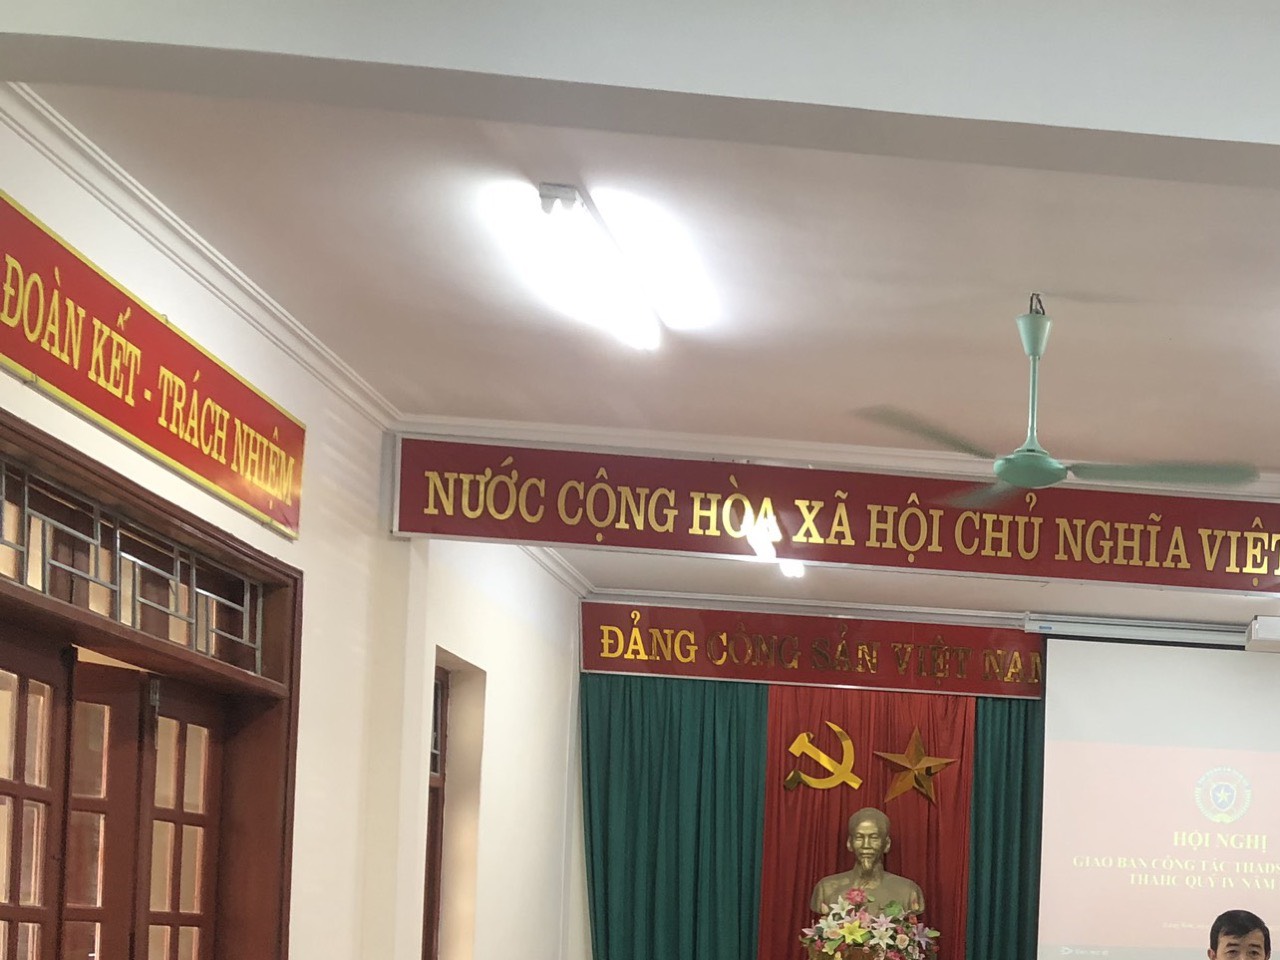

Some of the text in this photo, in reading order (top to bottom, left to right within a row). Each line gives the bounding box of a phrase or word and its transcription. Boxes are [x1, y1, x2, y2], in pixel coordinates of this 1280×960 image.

[0, 253, 86, 371] ĐOÀN
[88, 306, 142, 407] KẾT
[157, 365, 231, 464] TRÁCH
[231, 417, 295, 511] NHIỆM
[423, 456, 546, 524] NƯỚC
[557, 466, 679, 542] CỘNG
[688, 474, 783, 543] HÒA
[791, 489, 856, 546] XÃ
[865, 492, 945, 564] HỘI
[954, 491, 1044, 561] CHỦ
[1054, 512, 1192, 570] NGHĨA
[600, 610, 699, 664] ĐẢNG
[706, 621, 801, 670] CÔNG
[811, 622, 882, 675] SẢN
[890, 634, 974, 686] VIỆT
[1072, 855, 1114, 868] GIAO
[1118, 856, 1148, 869] BAN
[1173, 828, 1268, 854] HỘI NGHỊ
